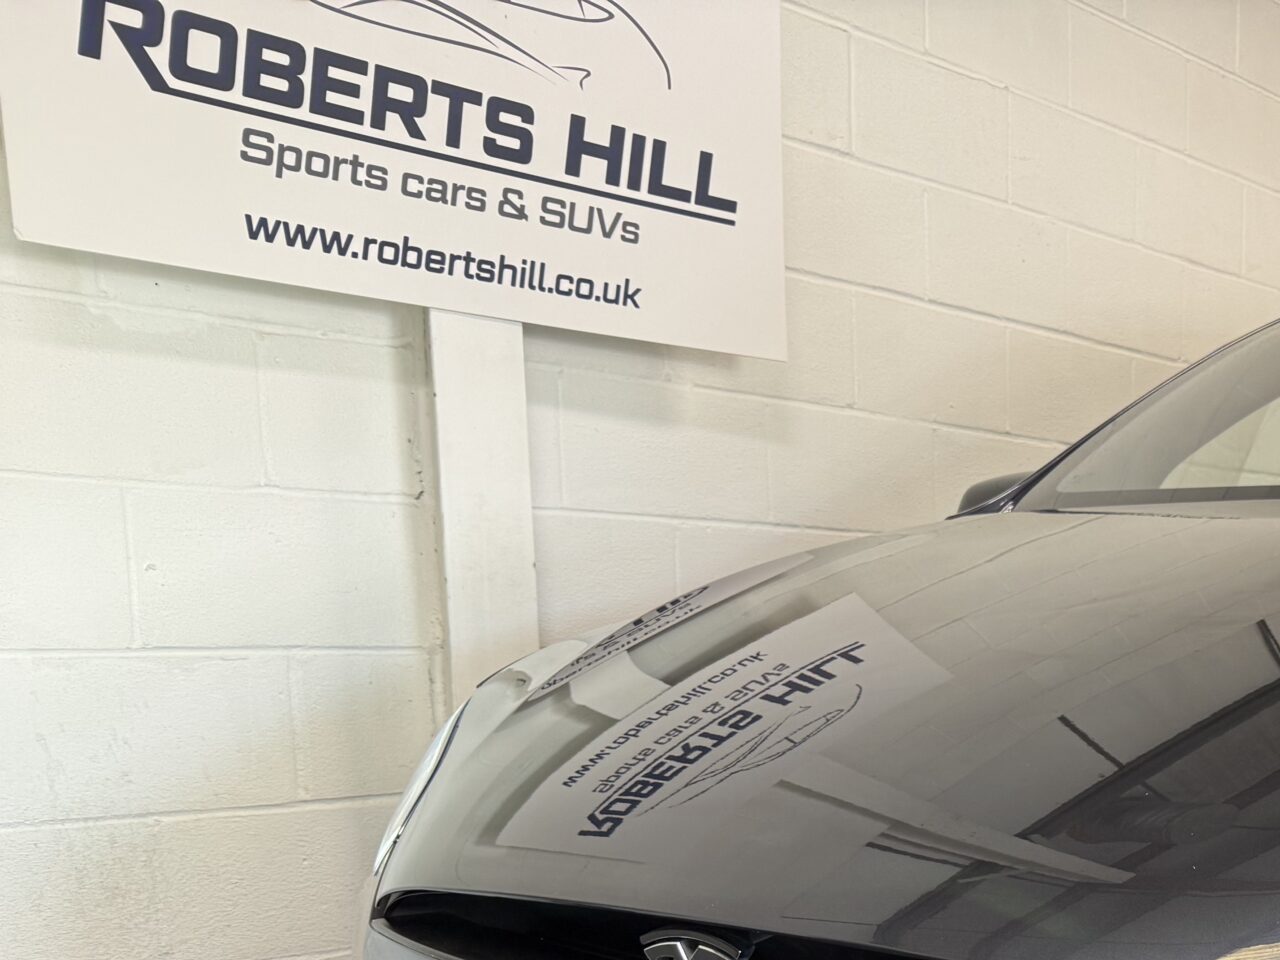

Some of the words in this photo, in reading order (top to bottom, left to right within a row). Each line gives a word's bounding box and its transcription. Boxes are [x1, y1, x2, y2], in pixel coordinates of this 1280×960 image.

[78, 0, 535, 166] ROBERTS
[564, 113, 738, 214] HILL
[241, 128, 389, 192] Sports
[401, 173, 487, 213] cars
[498, 188, 529, 222] &
[540, 197, 640, 245] SUVs
[244, 213, 642, 309] www.robertshill.co.uk
